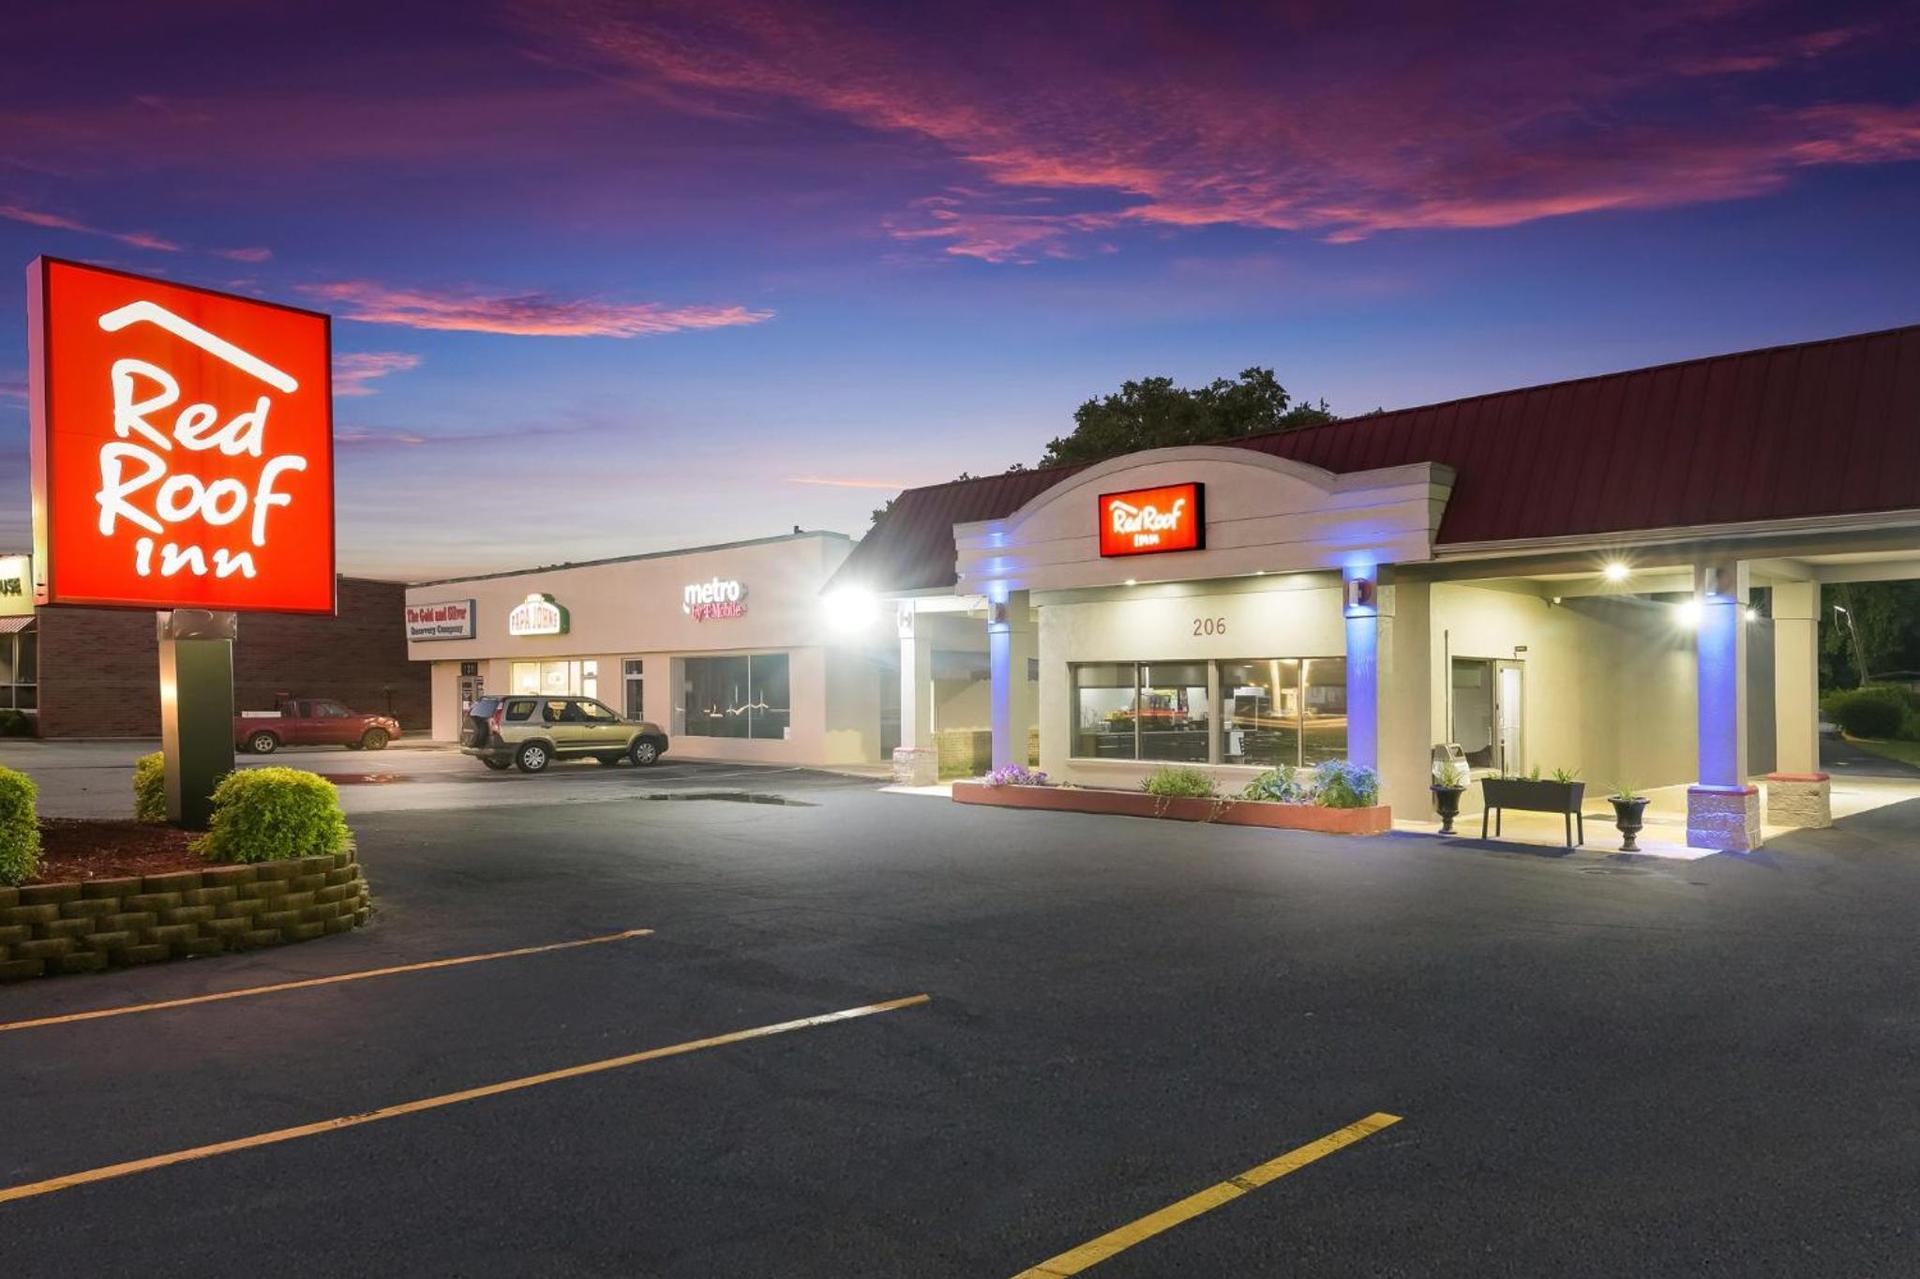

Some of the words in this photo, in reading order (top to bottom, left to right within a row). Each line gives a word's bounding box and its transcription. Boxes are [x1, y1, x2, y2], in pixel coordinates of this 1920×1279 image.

[111, 358, 271, 457] Red
[95, 441, 307, 546] Roof
[1113, 508, 1142, 534] Red
[1142, 498, 1185, 531] Roof
[685, 576, 740, 604] metro
[406, 608, 419, 623] The
[420, 607, 434, 623] Gold
[435, 606, 447, 621] and
[1193, 617, 1226, 636] 206
